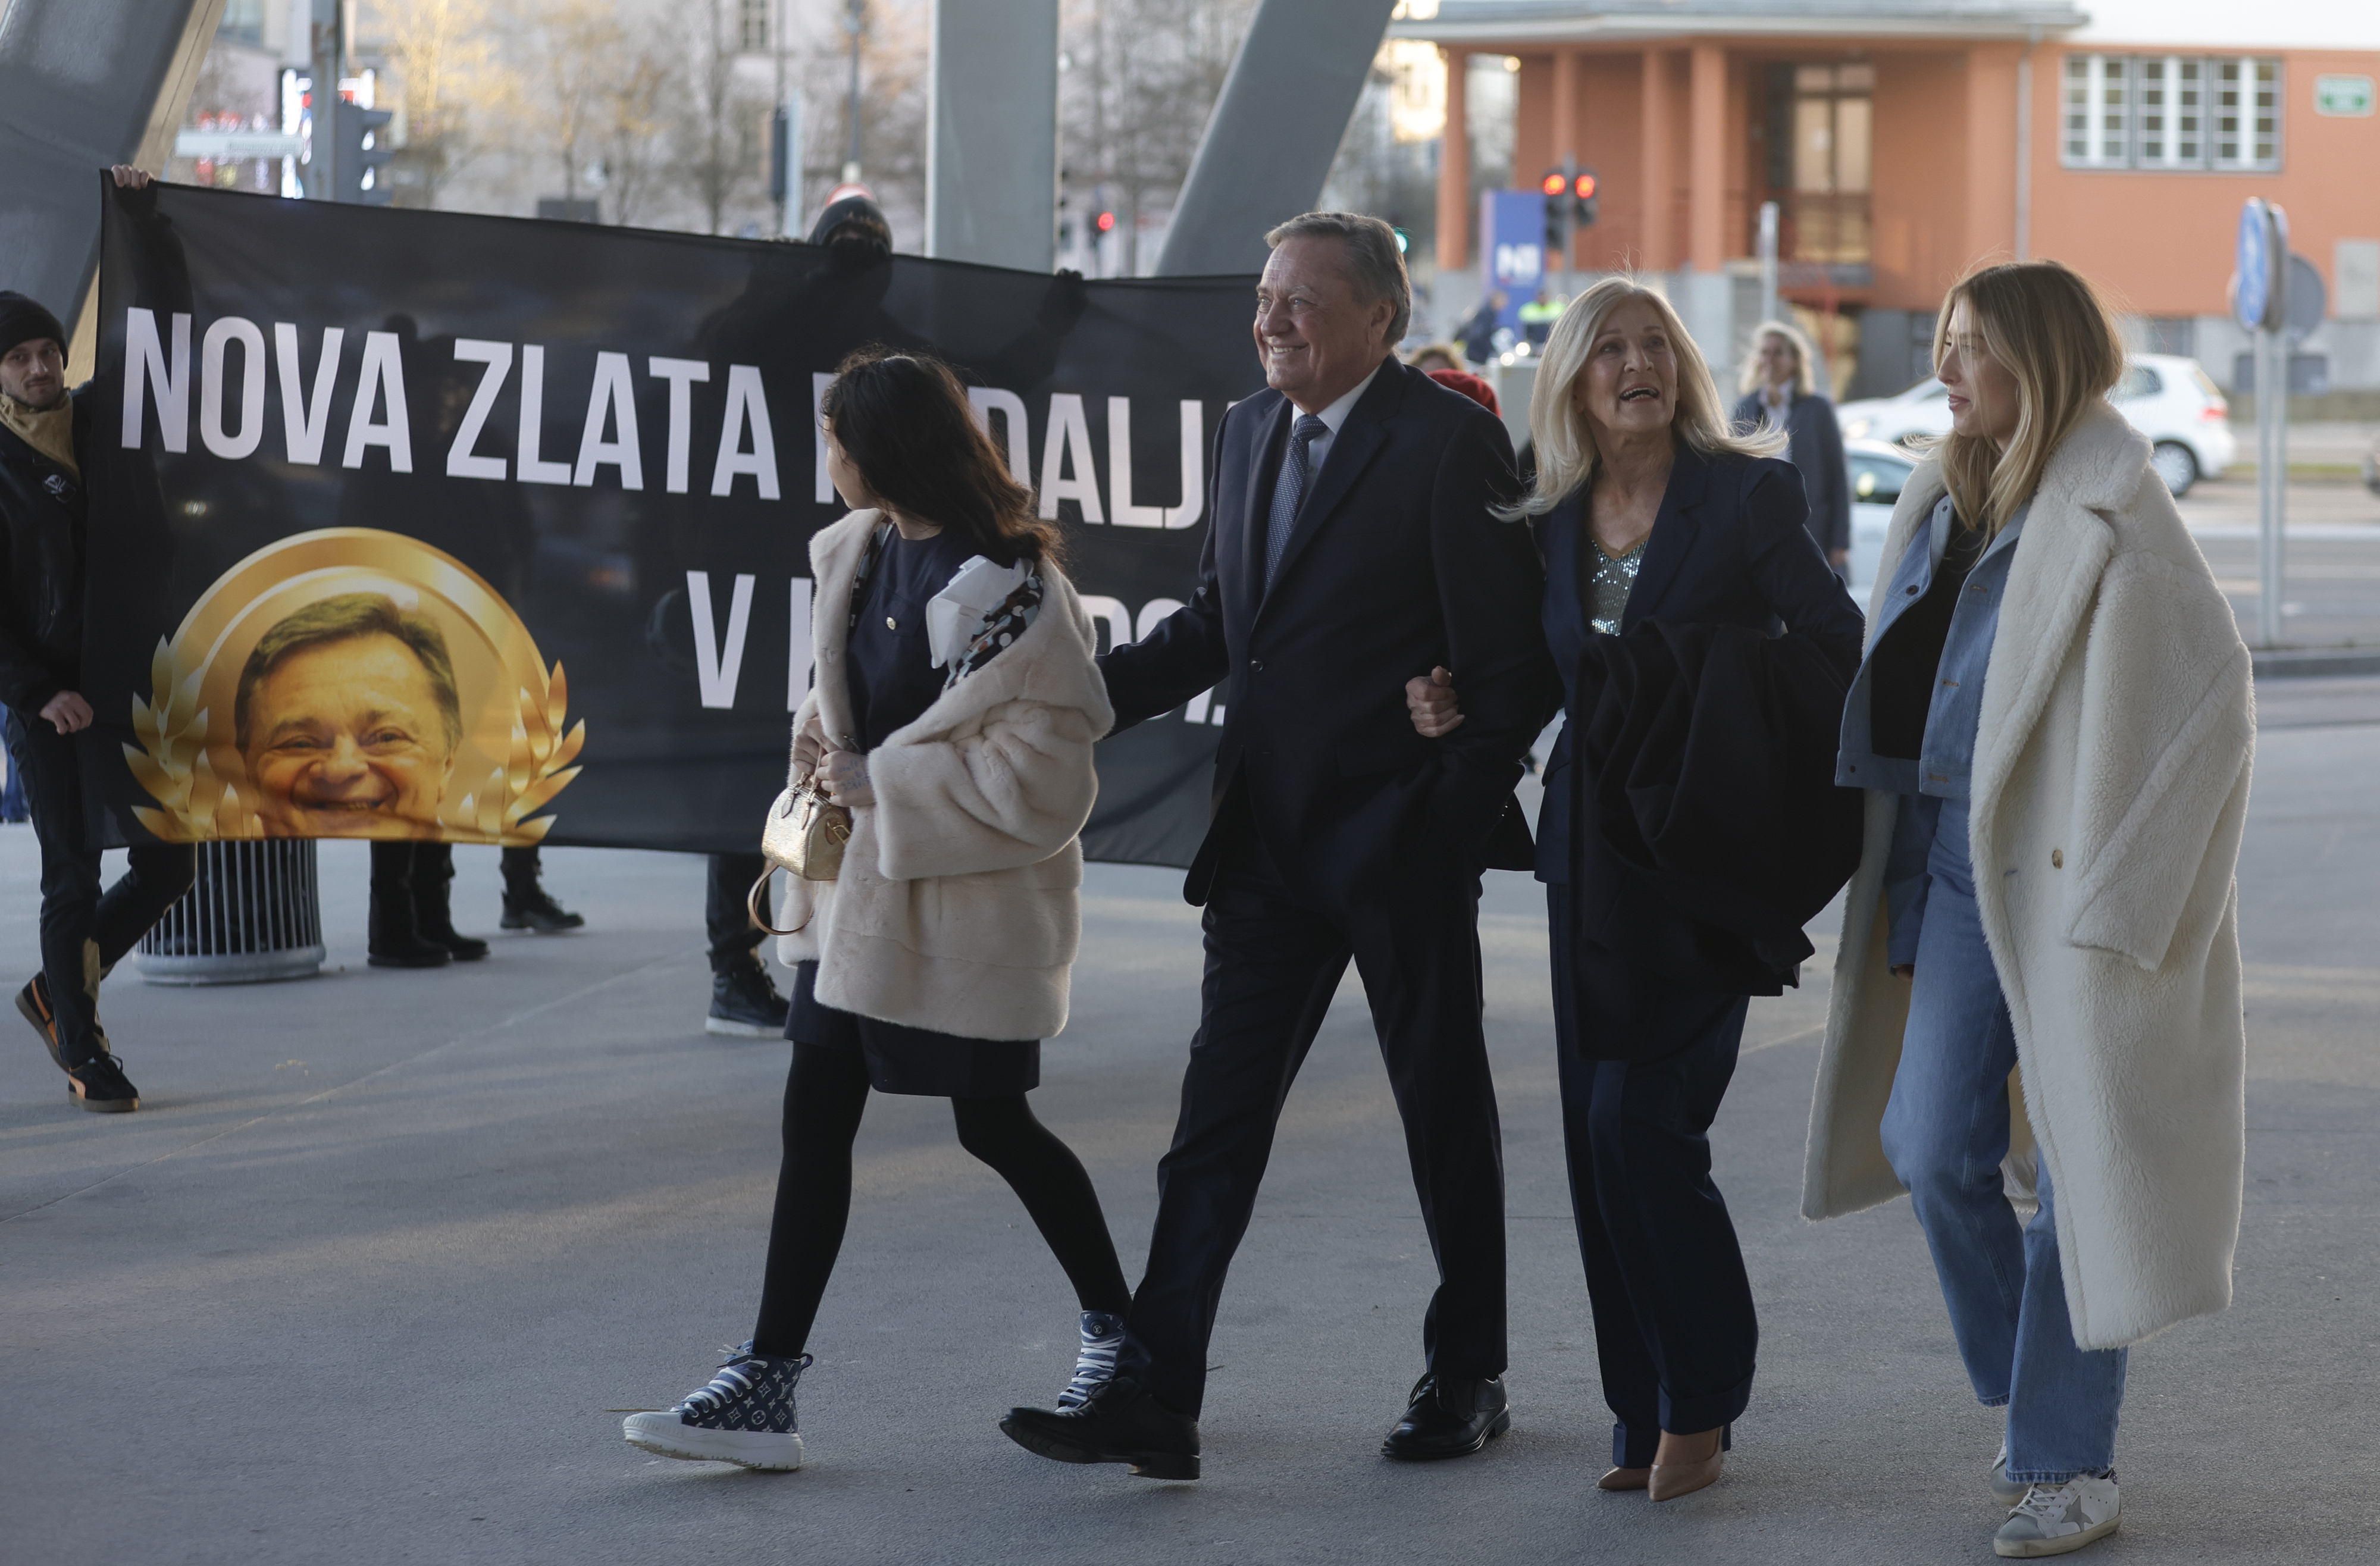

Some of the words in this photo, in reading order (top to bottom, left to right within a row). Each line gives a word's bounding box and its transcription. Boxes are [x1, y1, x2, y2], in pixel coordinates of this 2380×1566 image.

[121, 306, 412, 474] NOVA
[446, 337, 781, 501] ZLATA
[812, 371, 1241, 530] DALJ
[686, 570, 756, 710] V
